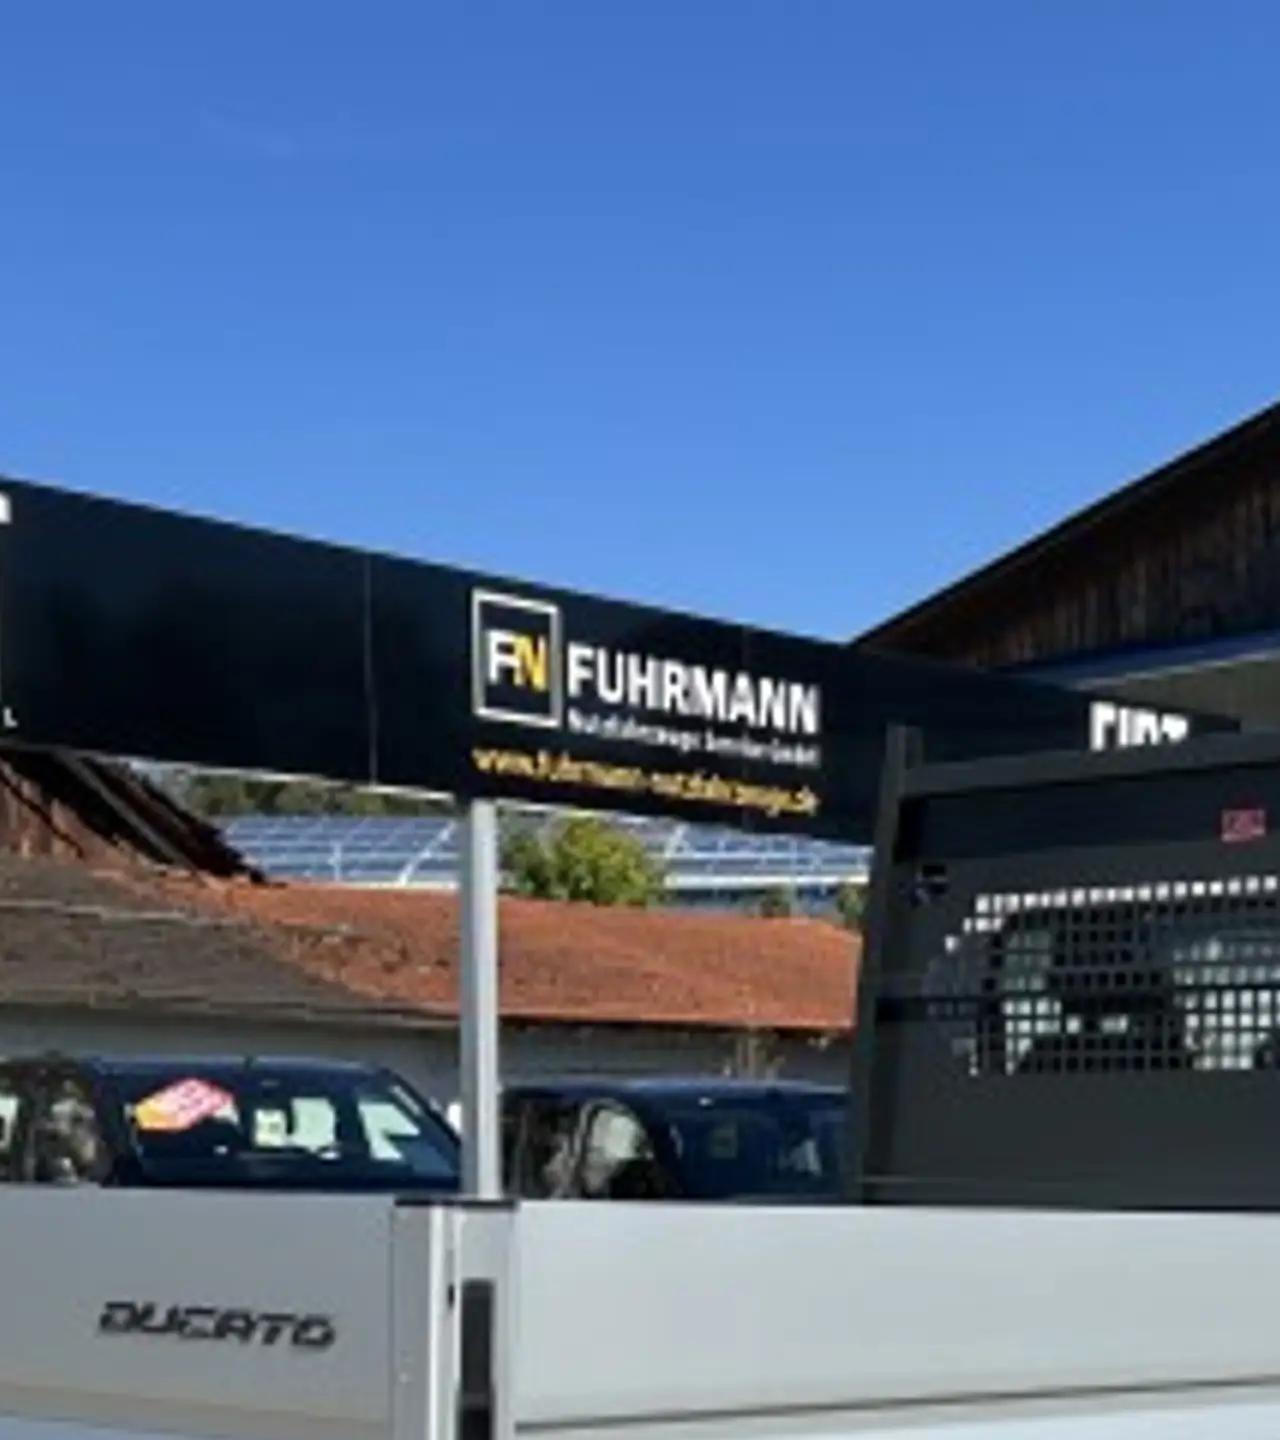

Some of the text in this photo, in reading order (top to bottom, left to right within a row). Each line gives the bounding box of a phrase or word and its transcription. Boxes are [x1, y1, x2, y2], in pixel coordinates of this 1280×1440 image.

[486, 630, 548, 690] FN
[568, 640, 819, 735] FUHRMANN
[98, 1301, 336, 1349] DUCATO
